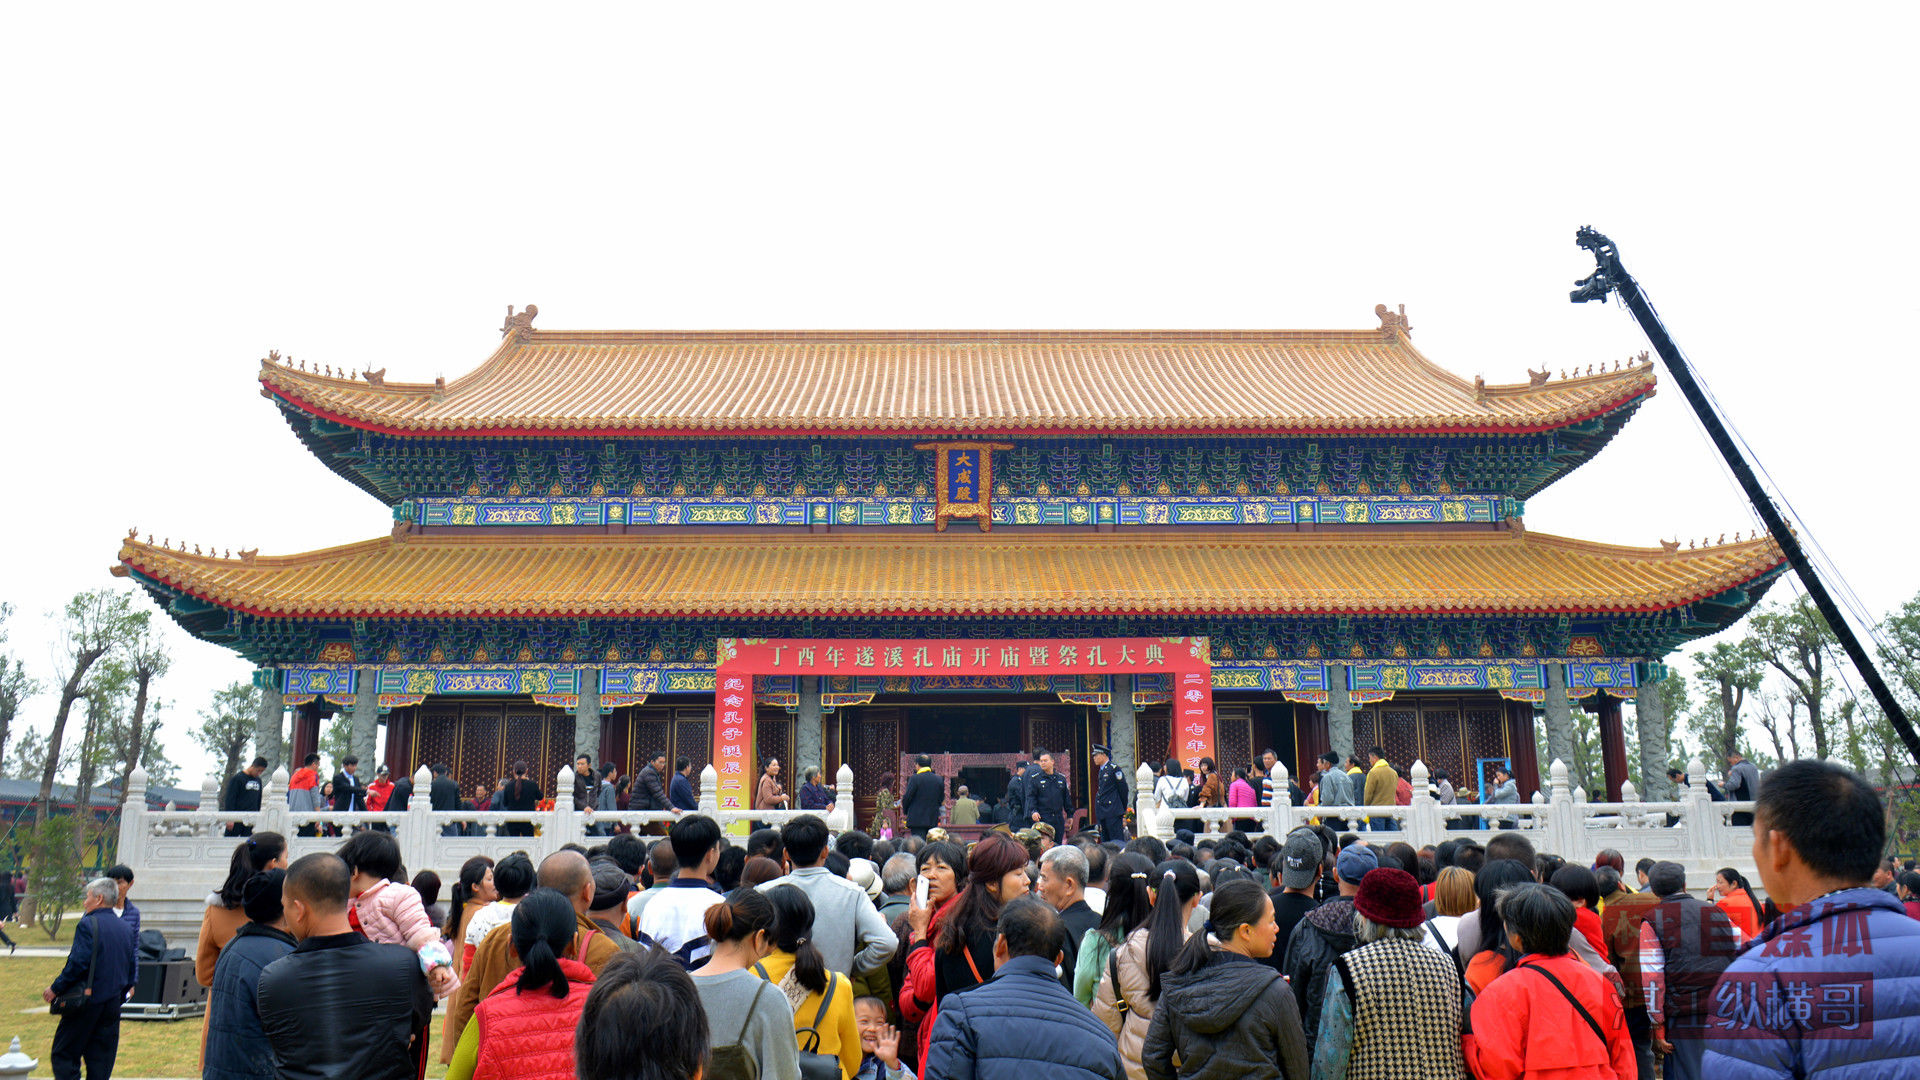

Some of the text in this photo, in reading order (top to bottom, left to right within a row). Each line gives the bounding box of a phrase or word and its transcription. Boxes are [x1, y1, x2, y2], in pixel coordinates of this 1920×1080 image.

[955, 451, 972, 500] 大成殿
[768, 644, 1165, 668] 丁酉年遂溪孔庙开庙暨祭孔大典
[721, 678, 744, 836] 纪念孔子诞辰二五
[1184, 674, 1207, 785] 二零一七年公
